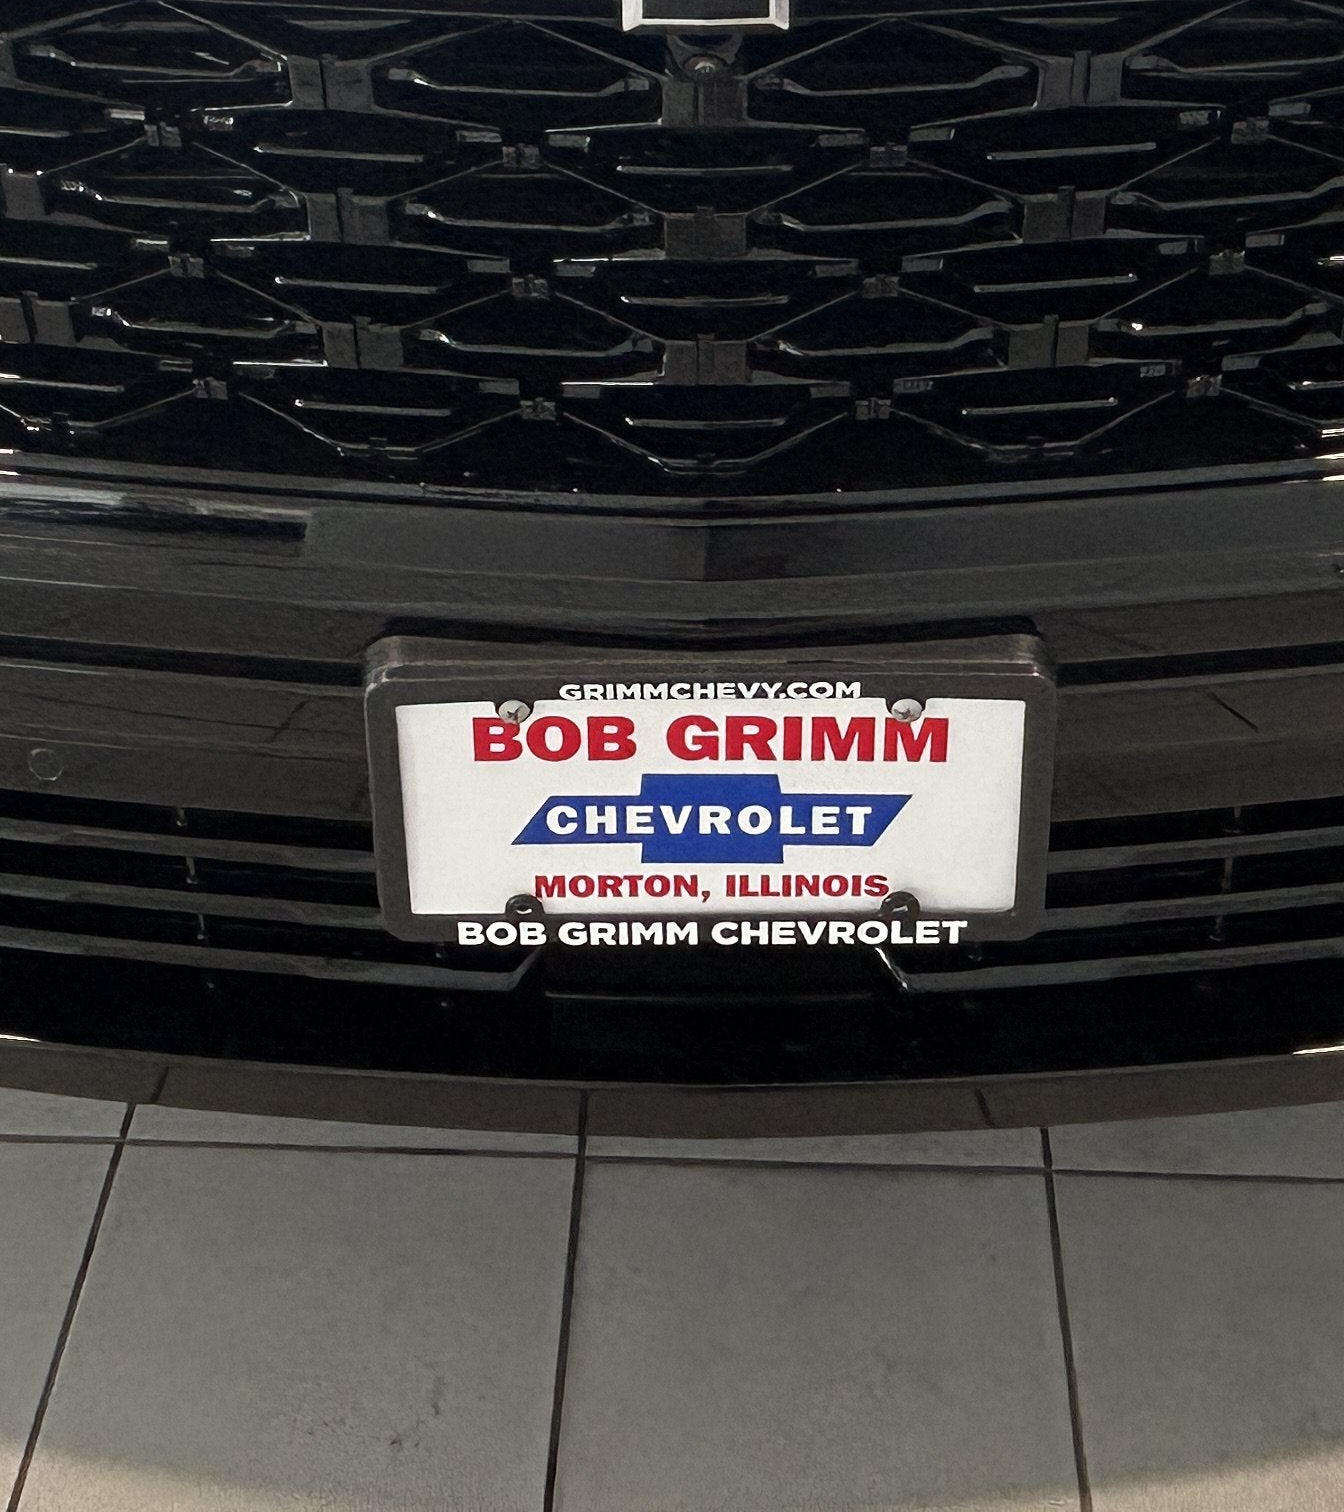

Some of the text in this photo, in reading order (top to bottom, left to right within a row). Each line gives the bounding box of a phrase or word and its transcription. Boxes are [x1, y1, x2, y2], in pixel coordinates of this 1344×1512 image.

[558, 681, 862, 701] GRIMMCHEVY.COM
[472, 715, 949, 763] BOB GRIMM
[545, 804, 873, 836] CHEVROLET
[534, 874, 891, 903] MORTON, ILLINOIS
[456, 919, 969, 947] BOB GRIMM CHEVROLET
